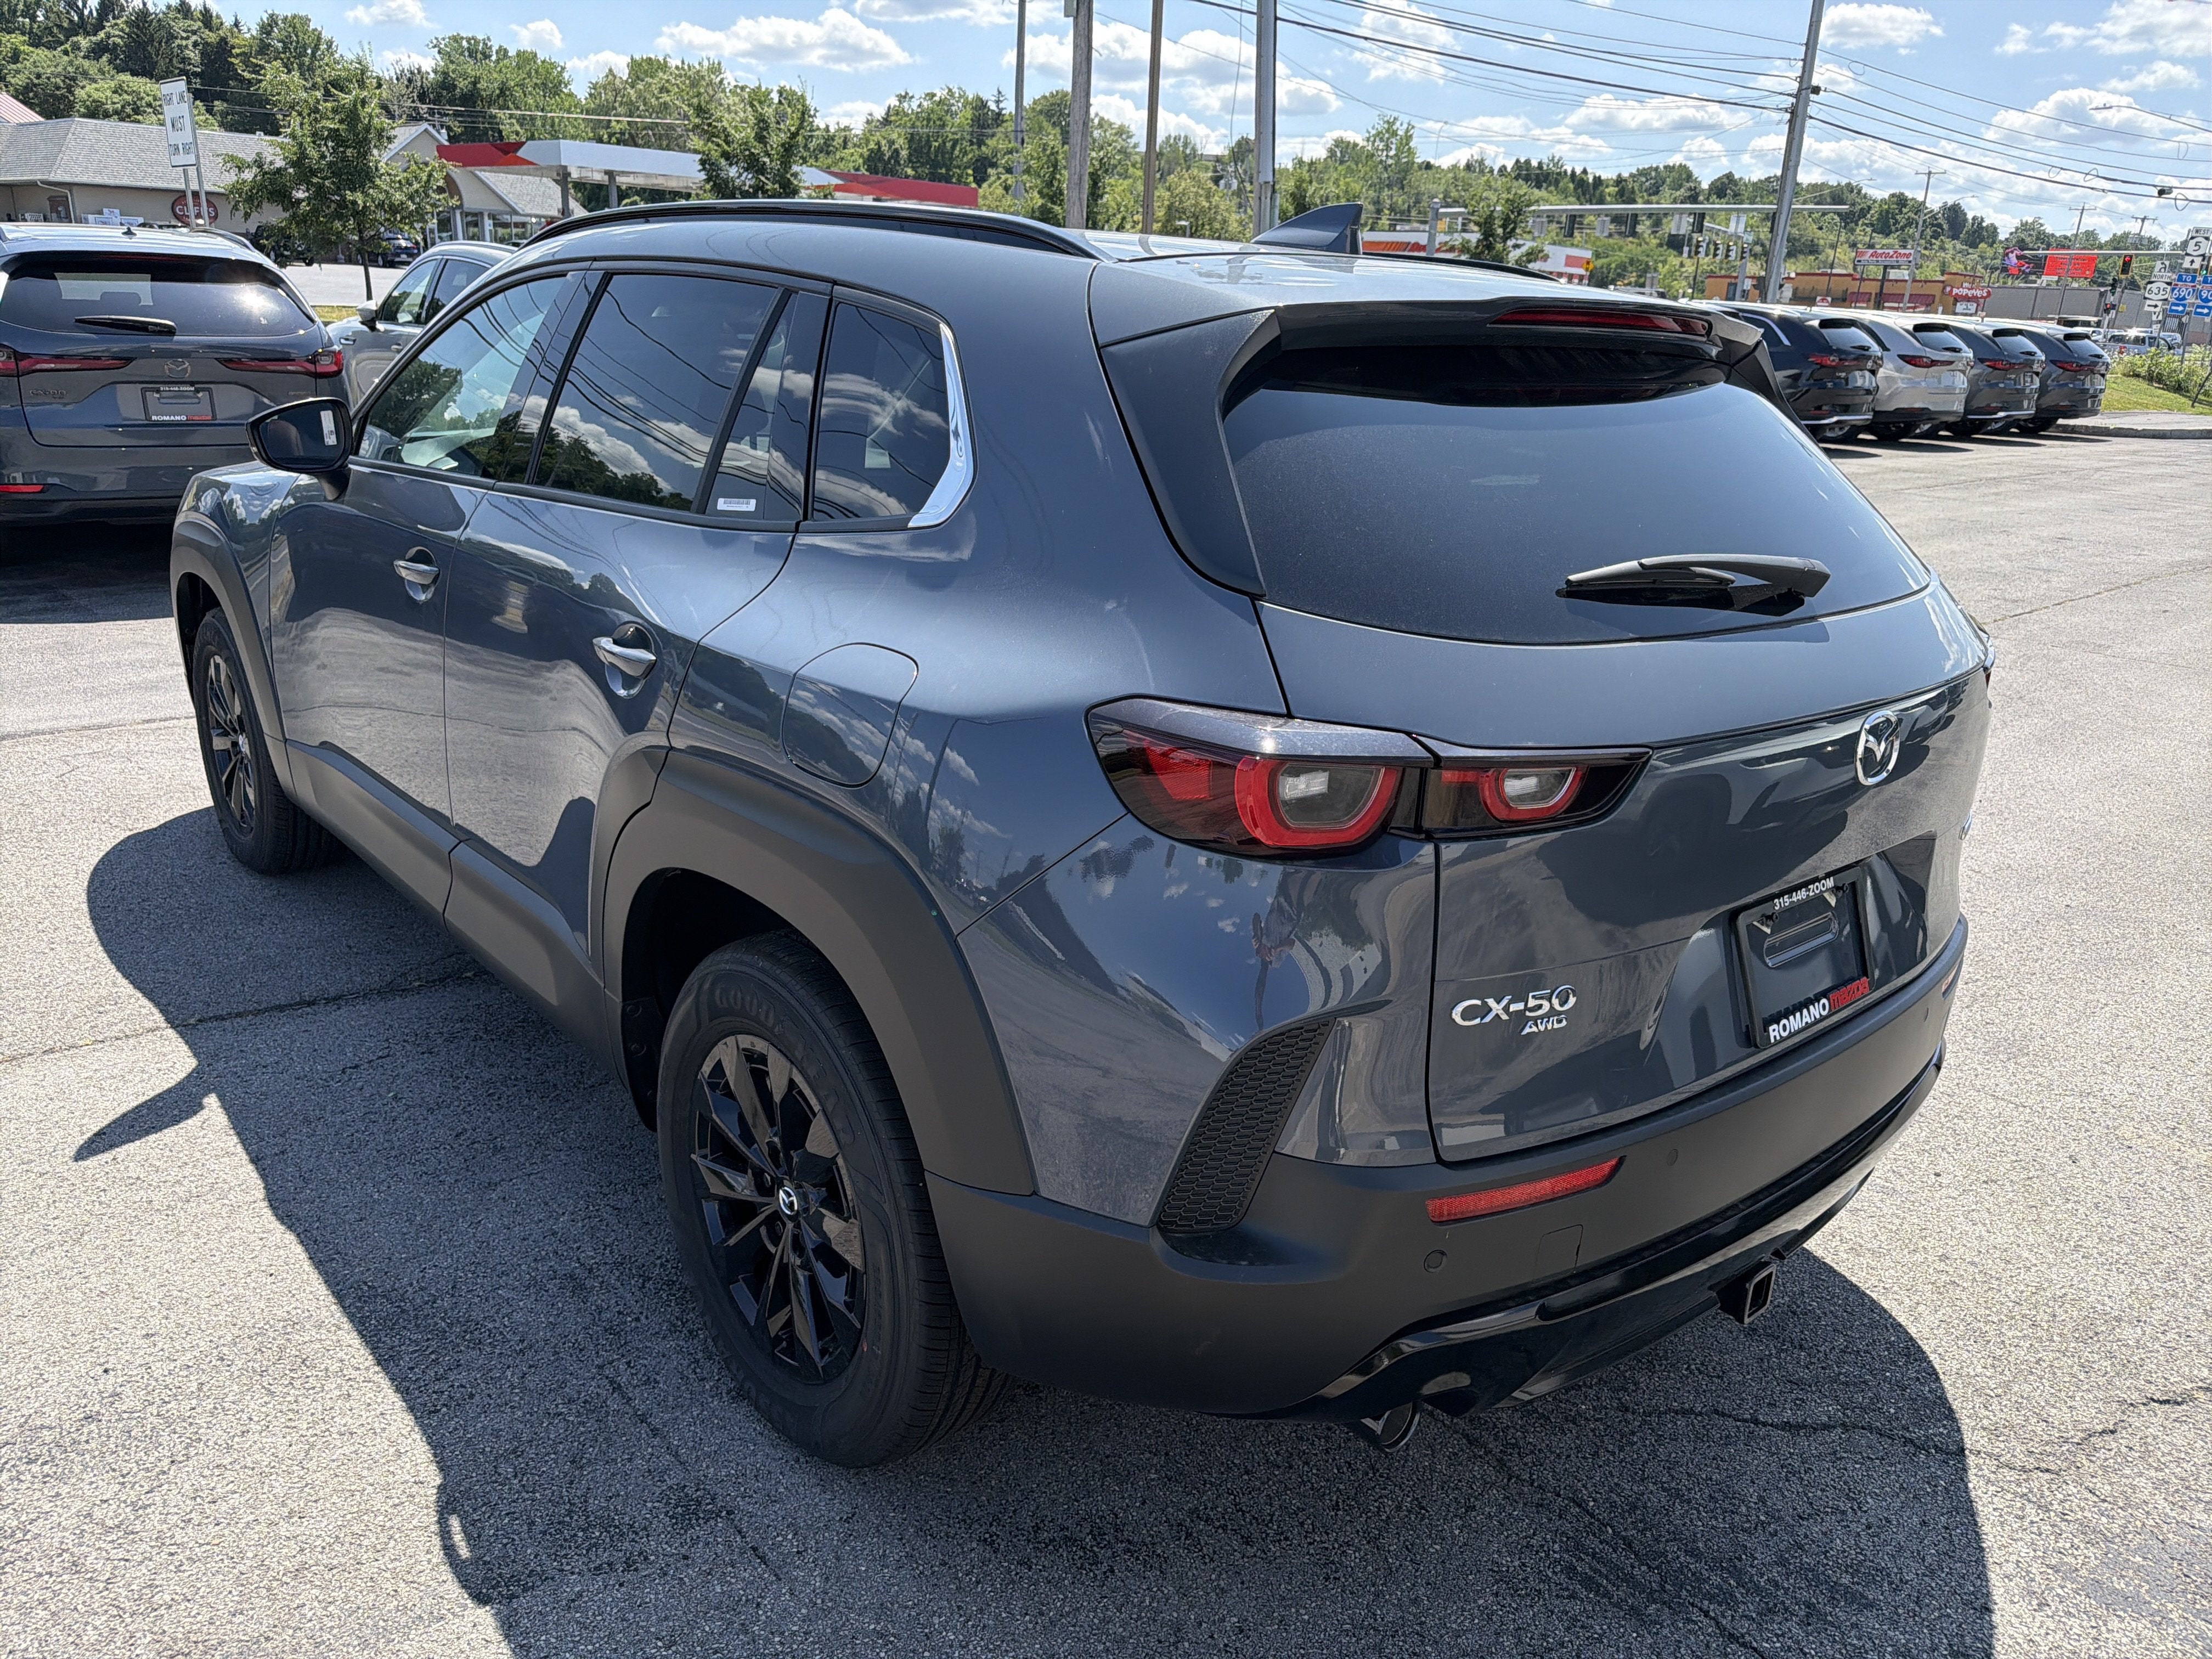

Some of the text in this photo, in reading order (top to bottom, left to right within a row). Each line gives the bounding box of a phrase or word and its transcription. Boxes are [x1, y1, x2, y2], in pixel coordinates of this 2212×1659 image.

[163, 91, 187, 106] RIGHT LANE
[170, 115, 185, 132] MUST
[169, 142, 194, 156] TURN RIGHT
[176, 205, 216, 217] CLFS
[2192, 241, 2202, 252] 5
[1869, 250, 1912, 259] AutoZone
[2147, 286, 2169, 296] 635
[2172, 287, 2193, 299] 690
[1773, 876, 1835, 911] 315-446-ZOOM
[1451, 984, 1577, 1026] CX-50
[1520, 1014, 1568, 1036] AWD
[1768, 998, 1830, 1043] ROMANO
